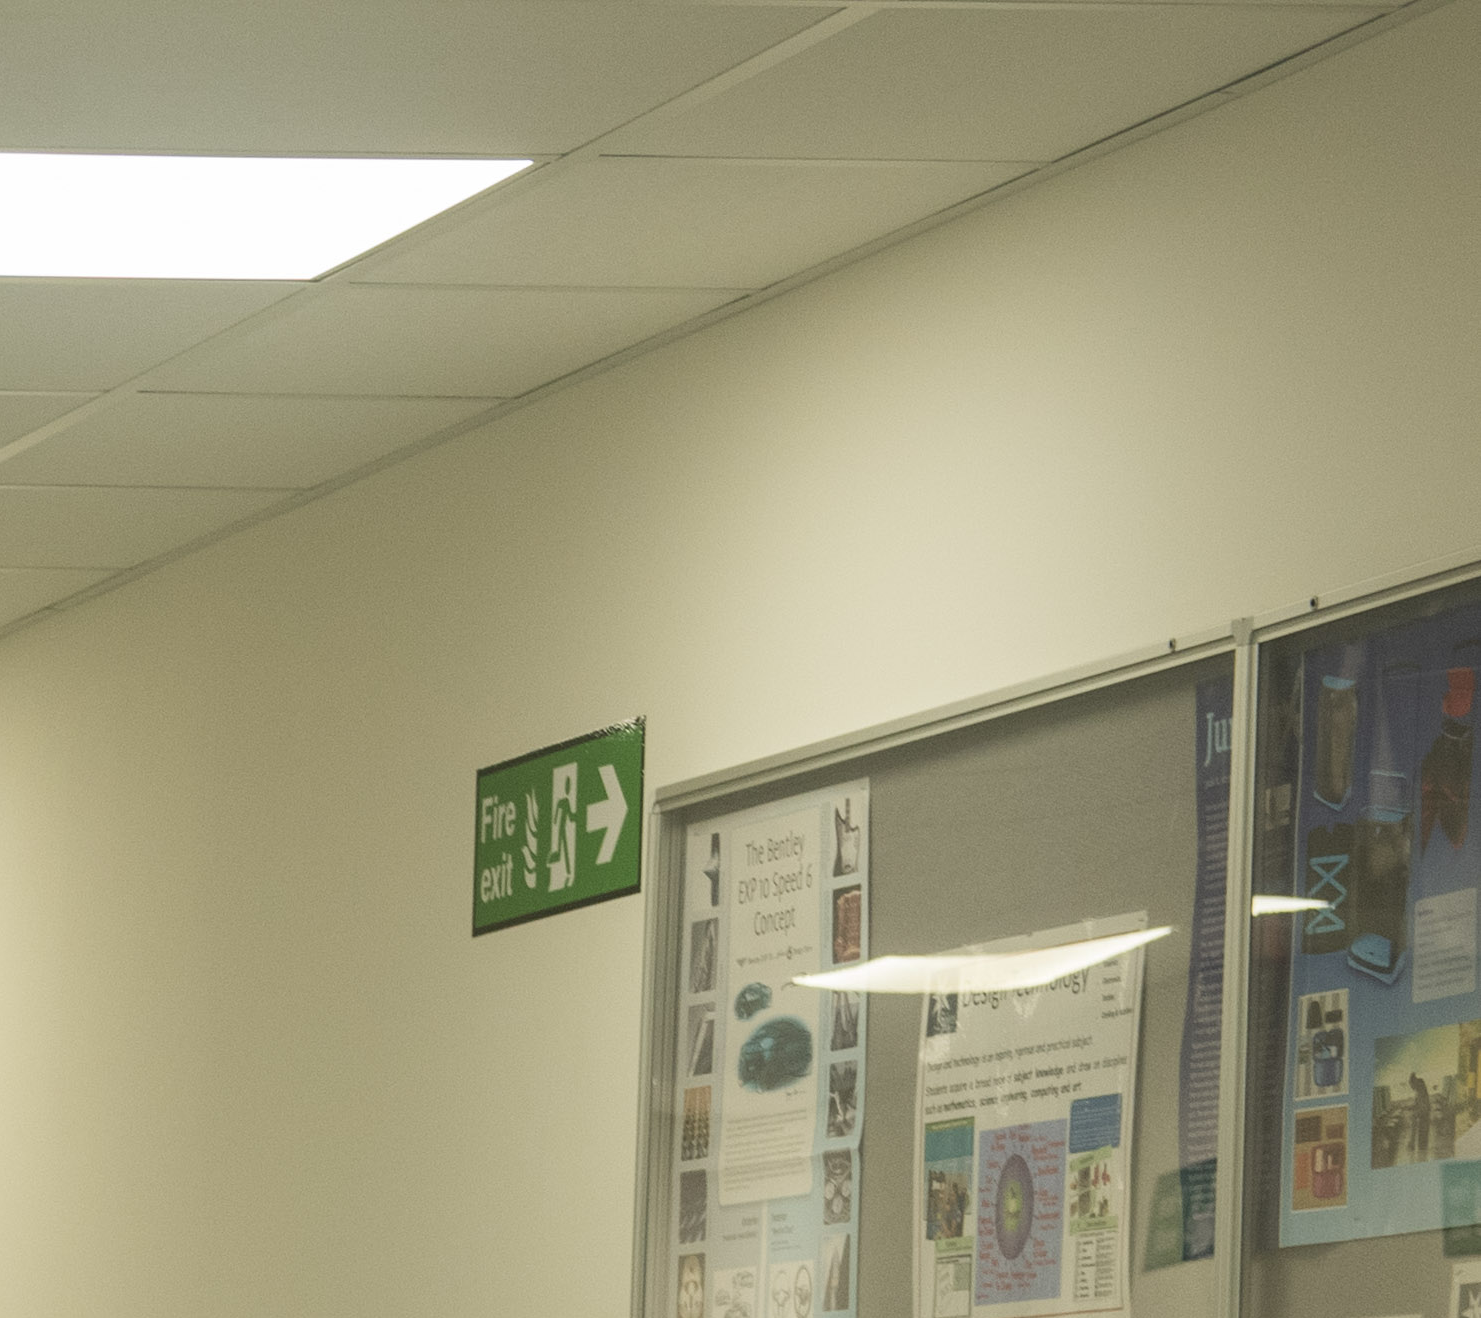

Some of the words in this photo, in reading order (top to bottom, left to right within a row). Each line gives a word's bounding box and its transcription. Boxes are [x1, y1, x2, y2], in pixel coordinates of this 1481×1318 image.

[480, 796, 517, 844] Fire
[745, 840, 764, 866] The
[767, 830, 805, 861] Bentley
[480, 857, 514, 904] exit
[738, 877, 757, 905] EXP
[772, 863, 804, 902] Speed
[753, 908, 796, 936] Concept
